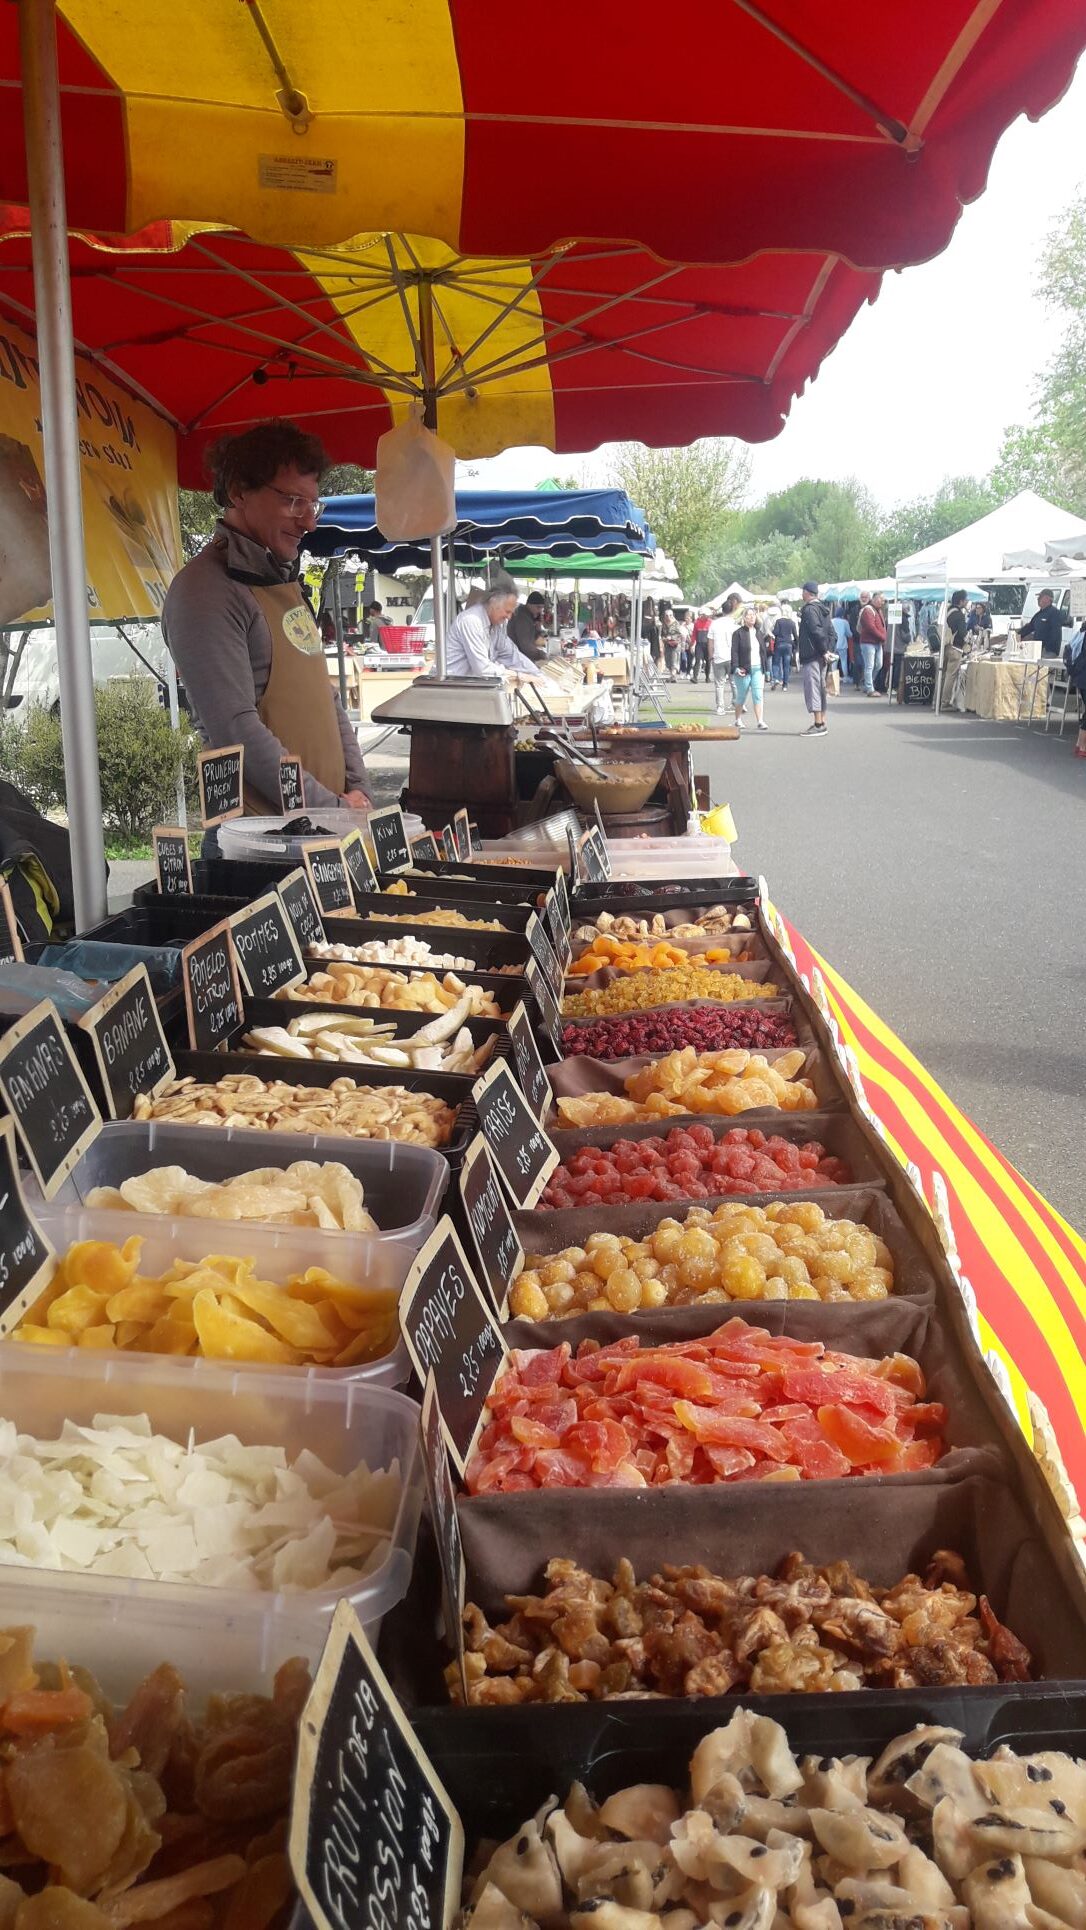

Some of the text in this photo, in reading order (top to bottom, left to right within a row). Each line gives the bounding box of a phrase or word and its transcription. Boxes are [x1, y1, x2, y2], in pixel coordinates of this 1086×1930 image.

[909, 658, 931, 670] VINS
[909, 685, 931, 698] BIO
[236, 919, 279, 960] POMMES
[103, 996, 148, 1065] BANANE
[9, 1035, 63, 1113] ANANAS
[483, 1089, 516, 1151] FRAISE
[415, 1265, 465, 1368] PAPAYES
[460, 1345, 480, 1398] 2,25
[354, 1678, 380, 1731] LA
[365, 1727, 407, 1930] ASSION
